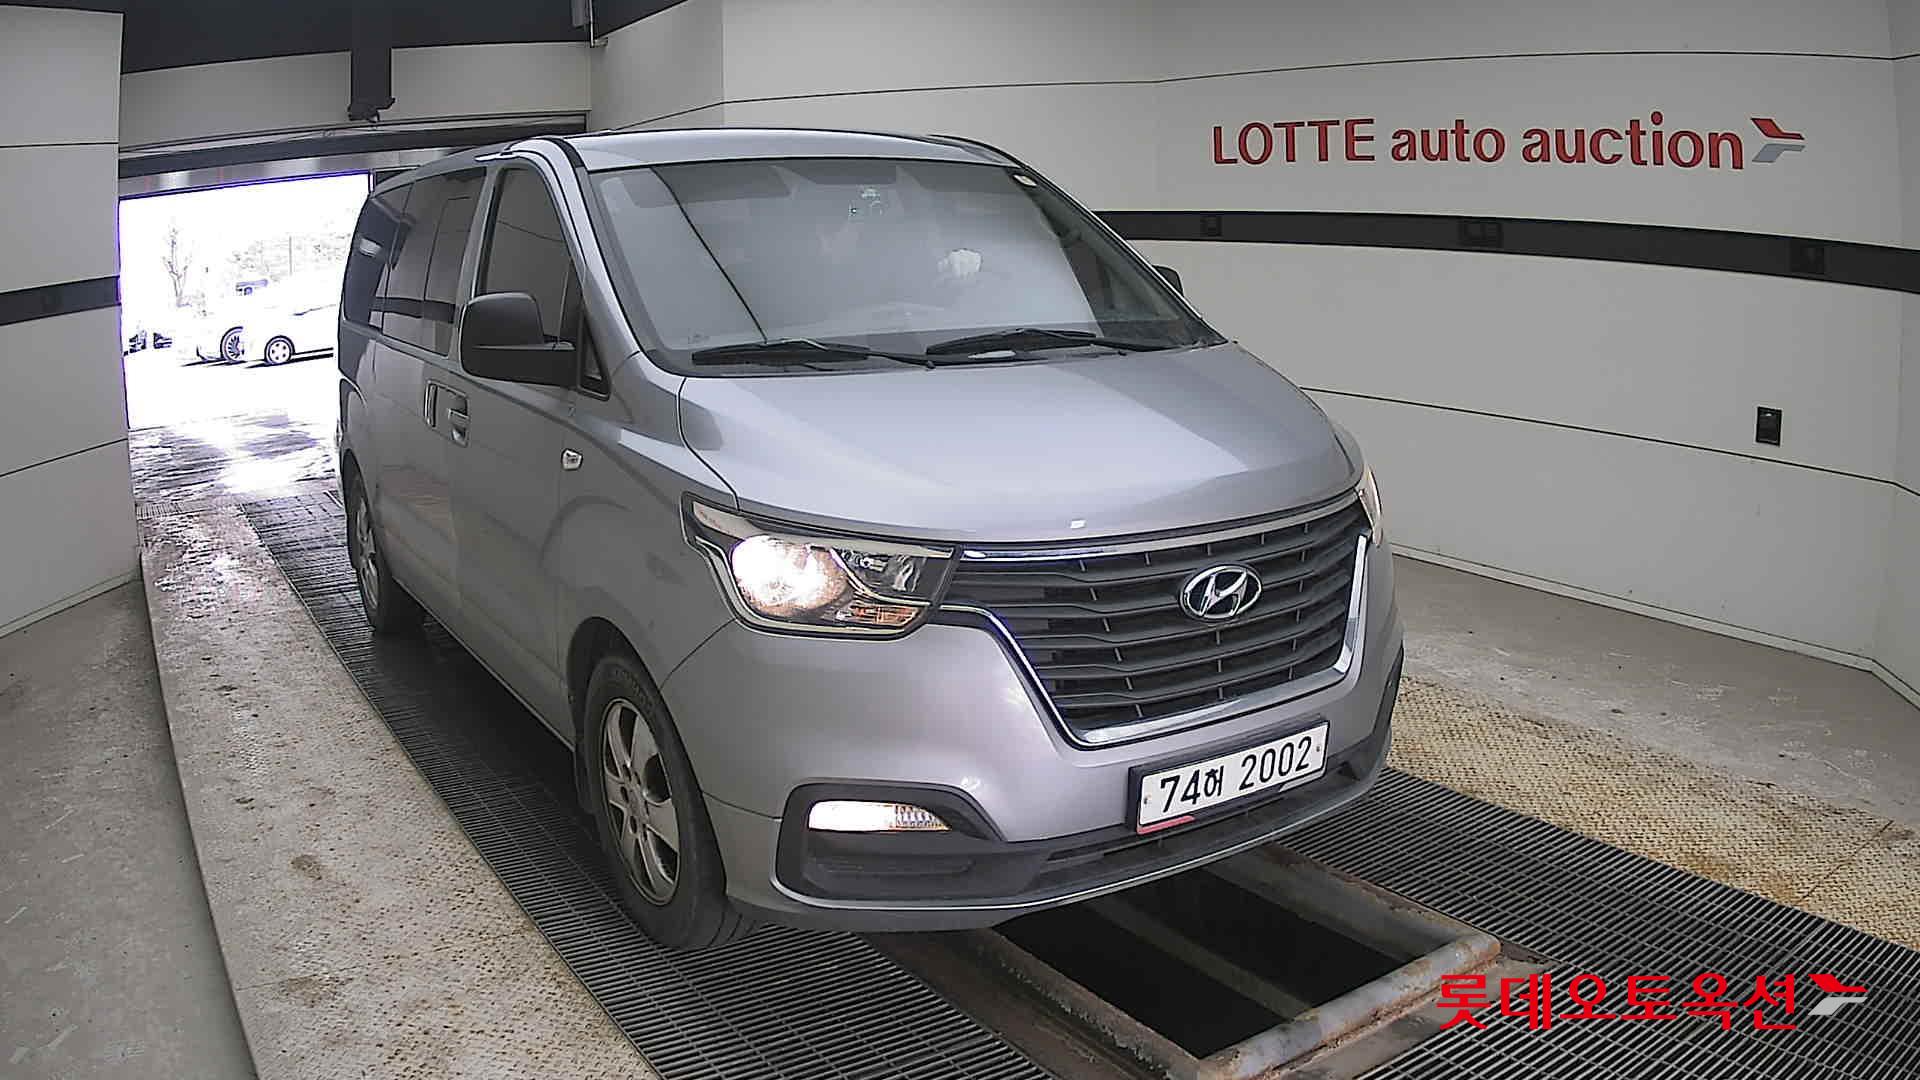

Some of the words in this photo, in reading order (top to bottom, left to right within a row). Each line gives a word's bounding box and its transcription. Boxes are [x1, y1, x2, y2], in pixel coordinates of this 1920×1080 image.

[1213, 118, 1375, 165] LOTTE
[1391, 120, 1506, 163] auto
[1522, 111, 1744, 170] auction
[1160, 765, 1223, 813] 74허
[1239, 736, 1312, 791] 2002
